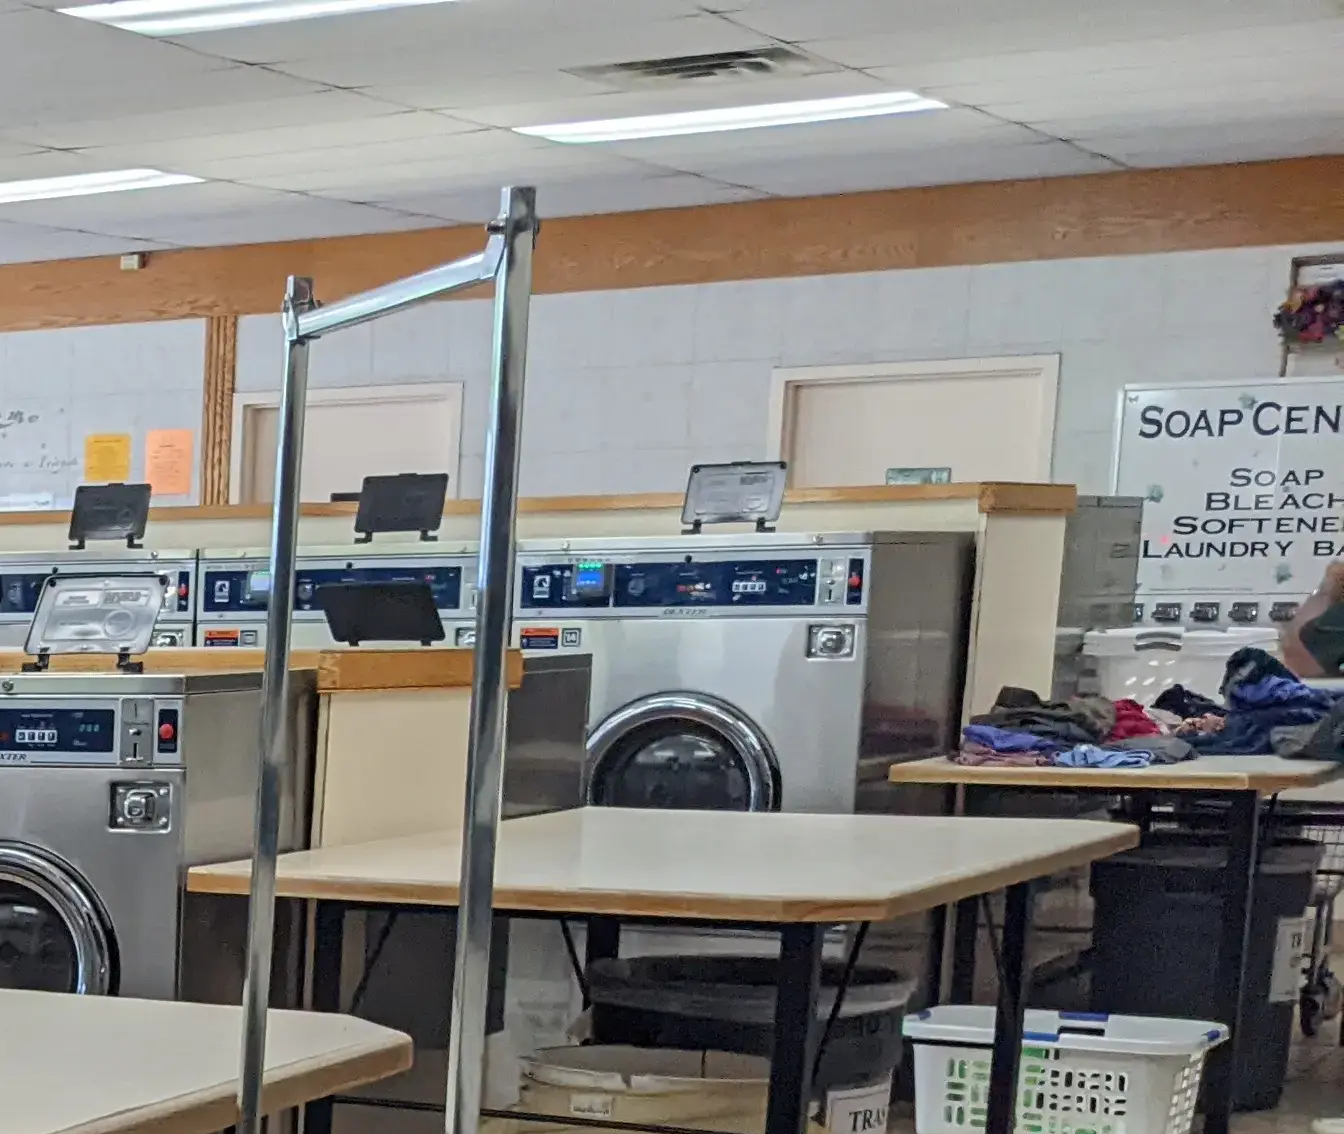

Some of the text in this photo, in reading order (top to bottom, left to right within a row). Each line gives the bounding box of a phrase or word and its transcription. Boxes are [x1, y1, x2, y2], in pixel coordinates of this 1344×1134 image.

[1138, 405, 1244, 439] SOAP
[1230, 467, 1325, 487] SOAP
[1173, 516, 1344, 535] SOFTENE
[1142, 540, 1294, 559] LAUNDRY
